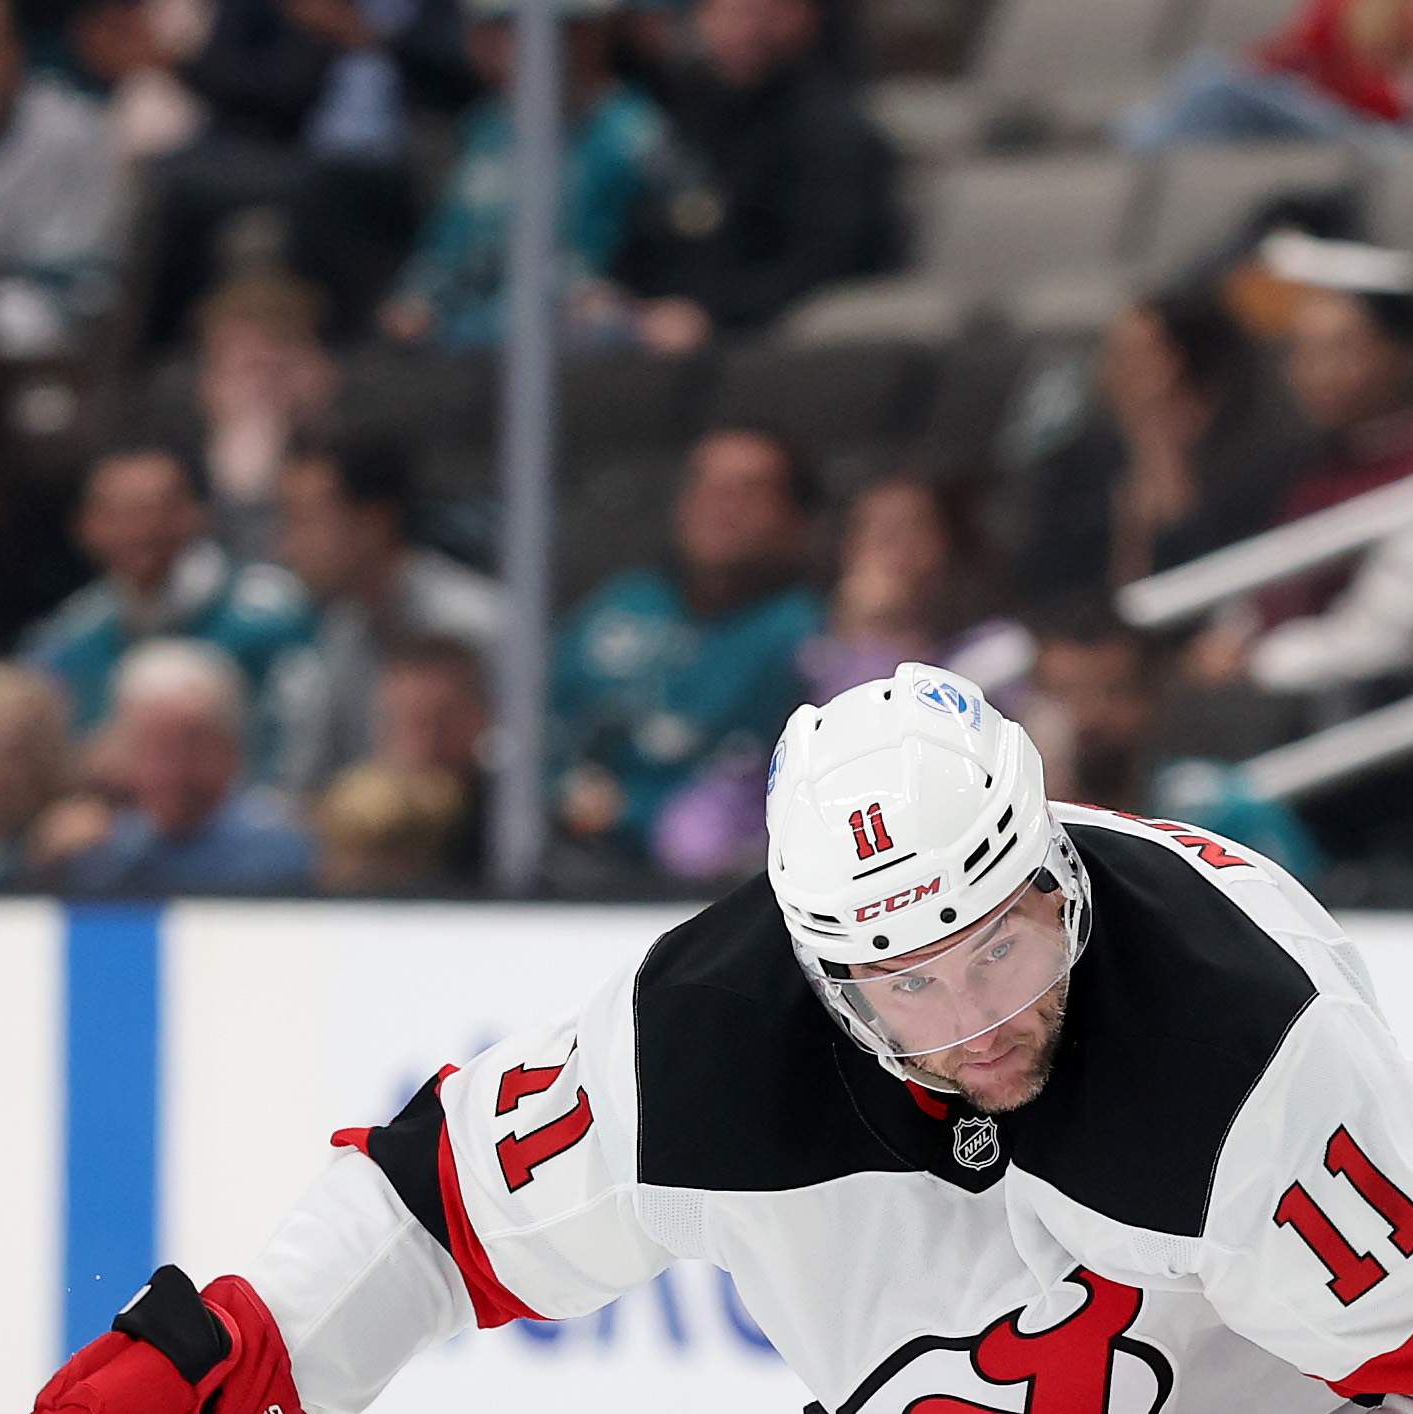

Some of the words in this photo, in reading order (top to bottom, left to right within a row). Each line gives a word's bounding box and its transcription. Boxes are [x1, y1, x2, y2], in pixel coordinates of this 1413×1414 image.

[848, 802, 894, 860] 11
[853, 876, 941, 923] CCM
[964, 1131, 990, 1158] NHL
